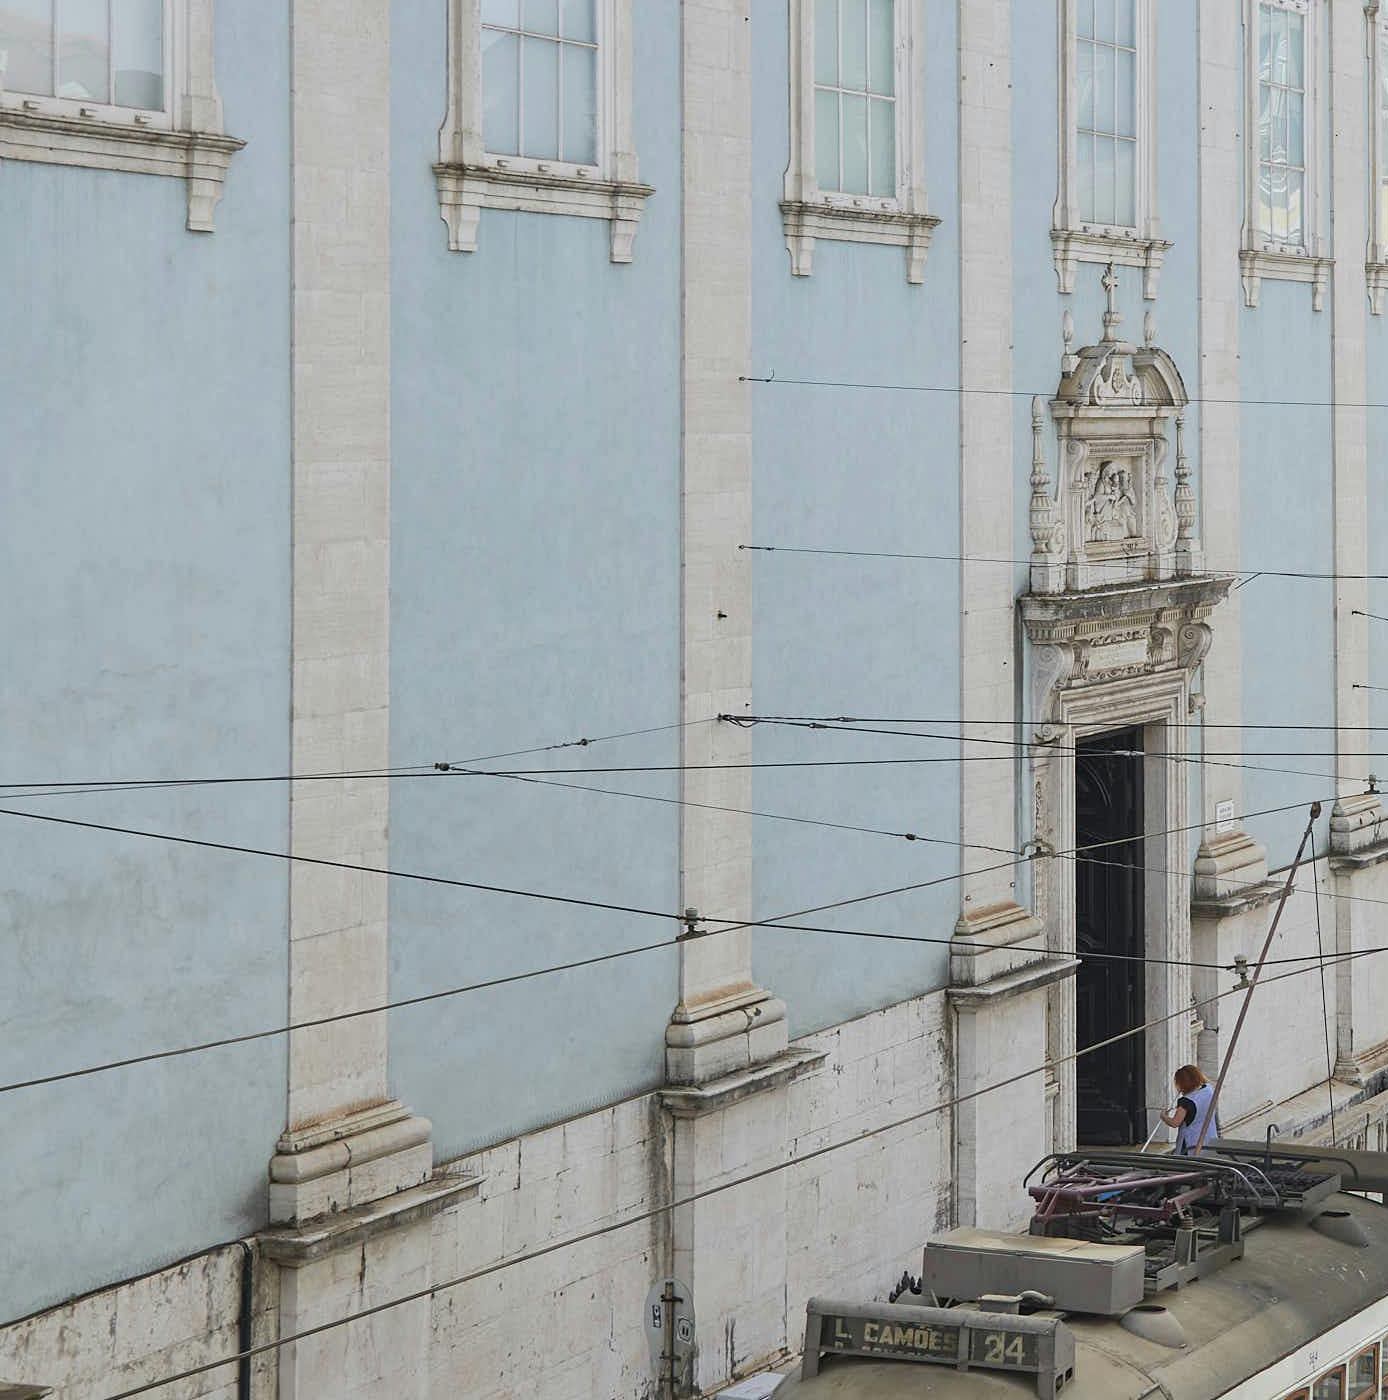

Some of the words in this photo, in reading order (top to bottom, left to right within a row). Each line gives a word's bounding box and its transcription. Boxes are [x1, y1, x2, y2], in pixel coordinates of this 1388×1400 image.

[834, 1318, 852, 1339] L.
[863, 1322, 959, 1352] CAMÕES
[984, 1332, 1026, 1366] 24
